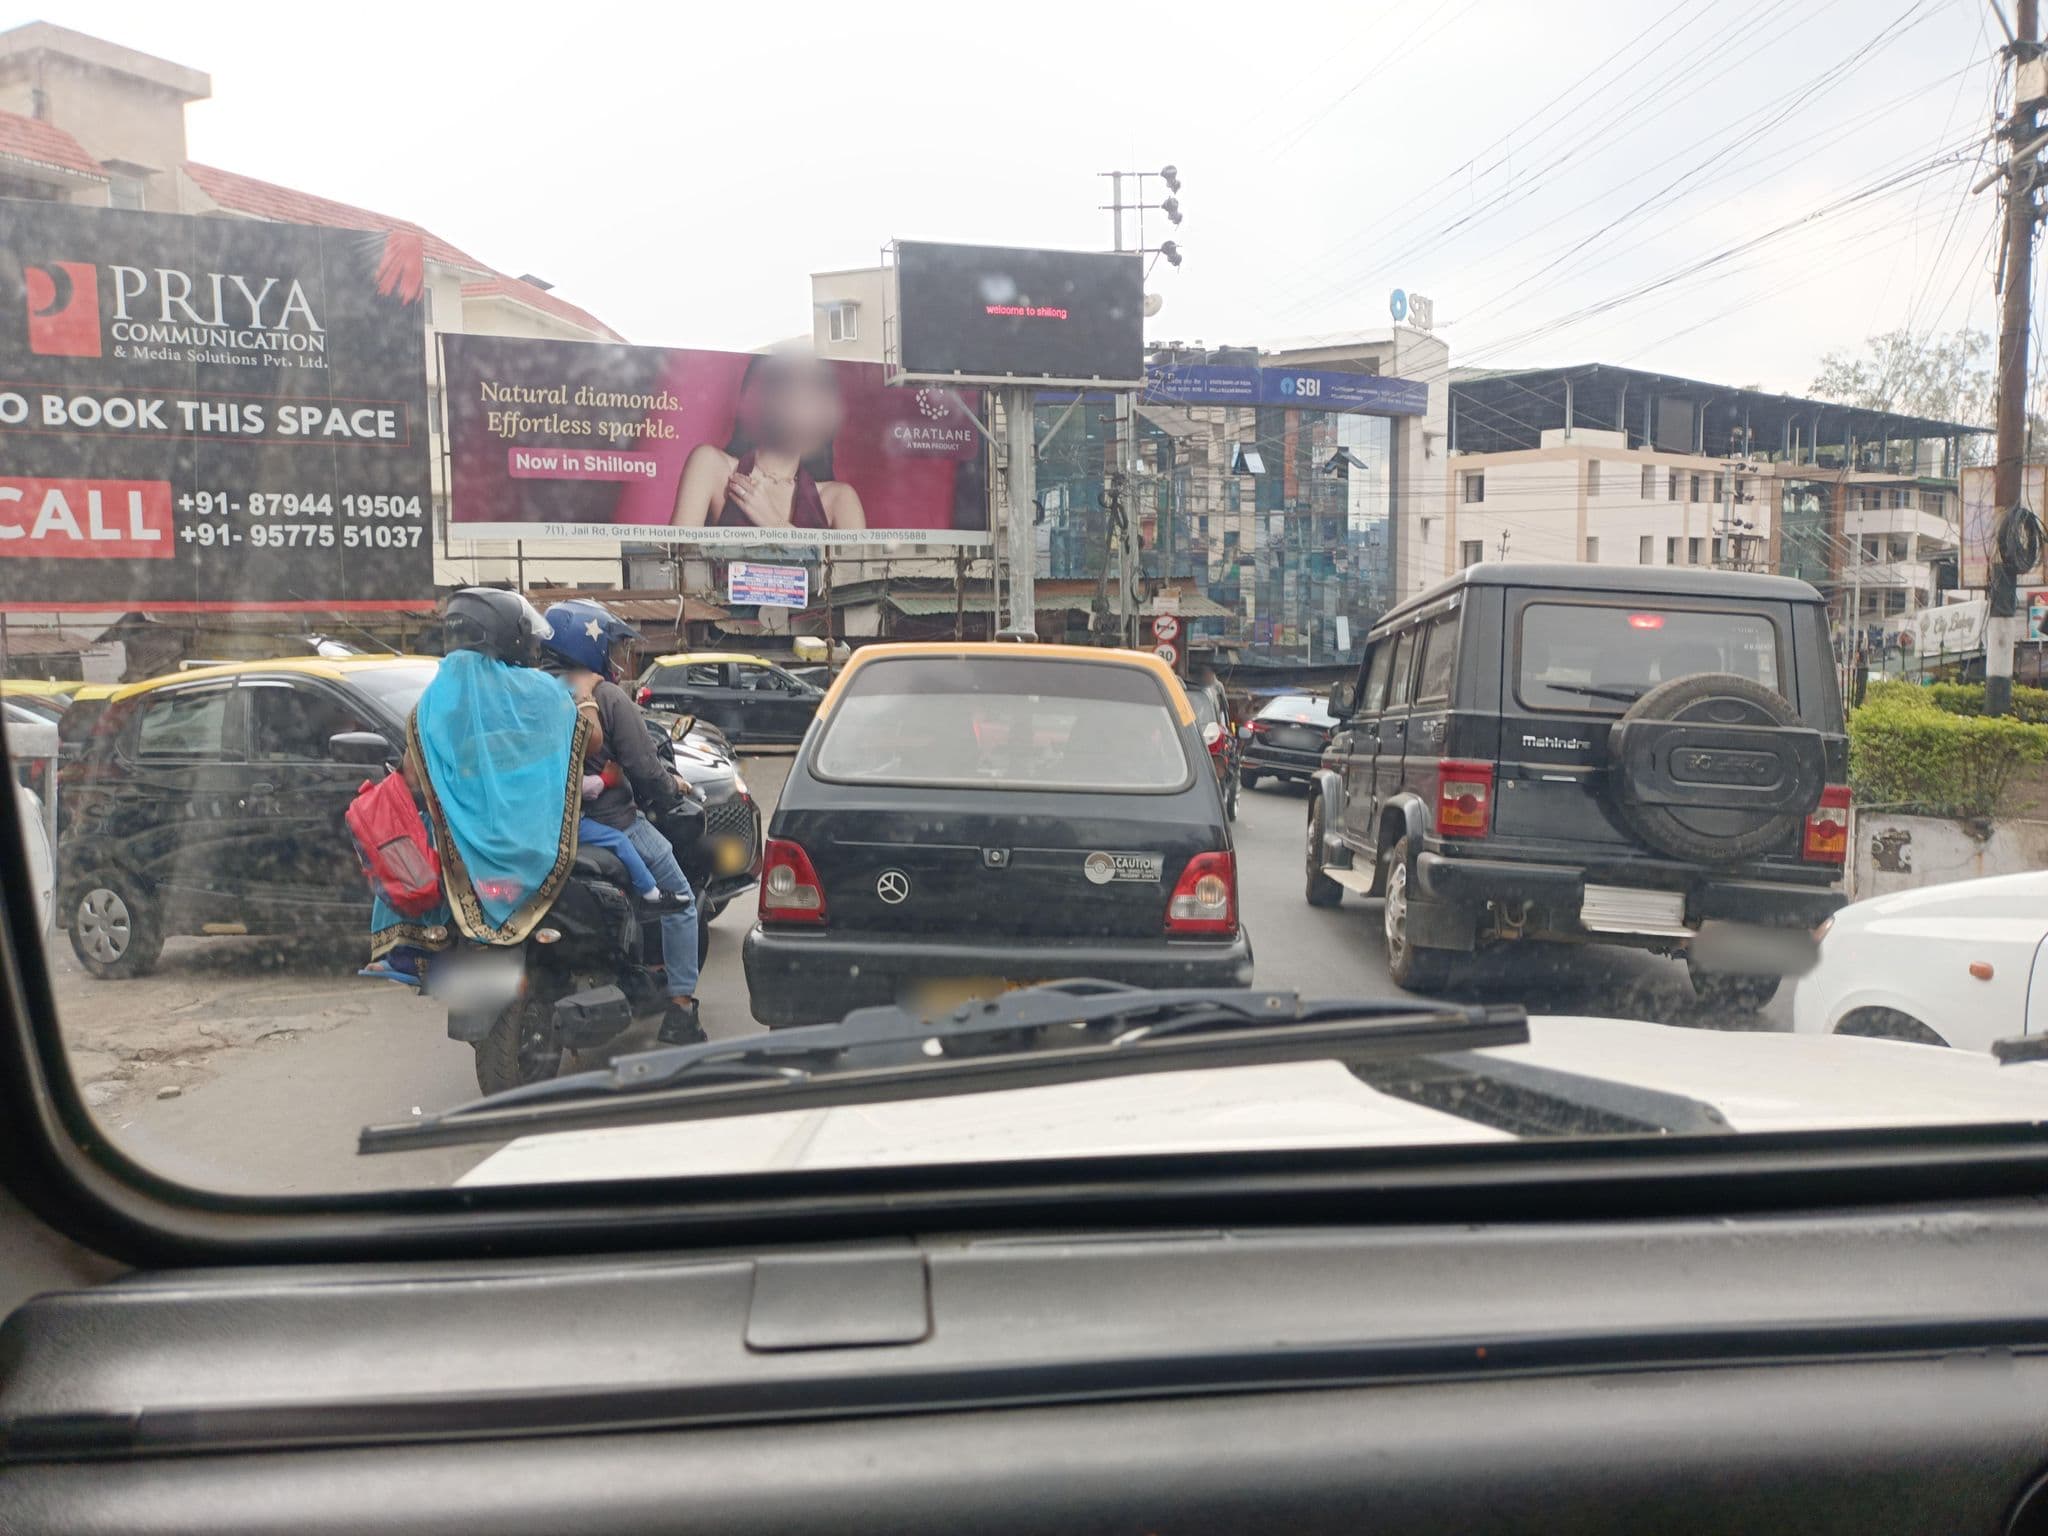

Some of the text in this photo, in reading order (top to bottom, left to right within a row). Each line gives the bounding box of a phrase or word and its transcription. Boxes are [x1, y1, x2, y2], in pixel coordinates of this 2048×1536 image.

[107, 265, 325, 333] PRIYA
[986, 304, 1024, 317] welcome
[1026, 307, 1036, 317] to
[1408, 292, 1434, 330] SBI
[111, 322, 325, 353] COMMUNICATION
[113, 346, 329, 369] & Media Solutions Pvt. Ltd.
[481, 382, 684, 412] Natural diamonds.
[1296, 378, 1321, 397] SBI
[42, 395, 167, 430] BOOK
[177, 402, 265, 435] THIS
[277, 406, 396, 438] SPACE
[487, 411, 680, 442] Effortless sparkle.
[894, 427, 972, 442] CARATLANE
[913, 441, 931, 450] TATA
[931, 442, 959, 451] PRODUCT
[516, 453, 657, 477] Now in Shillong
[0, 486, 161, 541] CALL
[178, 491, 422, 518] +91- 87944 19504
[179, 524, 423, 548] +91- 95775 51037
[544, 525, 568, 537] 7(1),
[571, 527, 589, 536] Jail
[591, 527, 609, 538] Rd,
[611, 528, 631, 537] Grd
[649, 529, 676, 538] Hotel
[678, 529, 721, 541] Pegasus
[723, 530, 757, 541] Crown,
[760, 531, 789, 540] Police
[791, 531, 820, 542] Bazar,
[822, 531, 858, 542] Shillong
[1522, 735, 1591, 751] Mahindra
